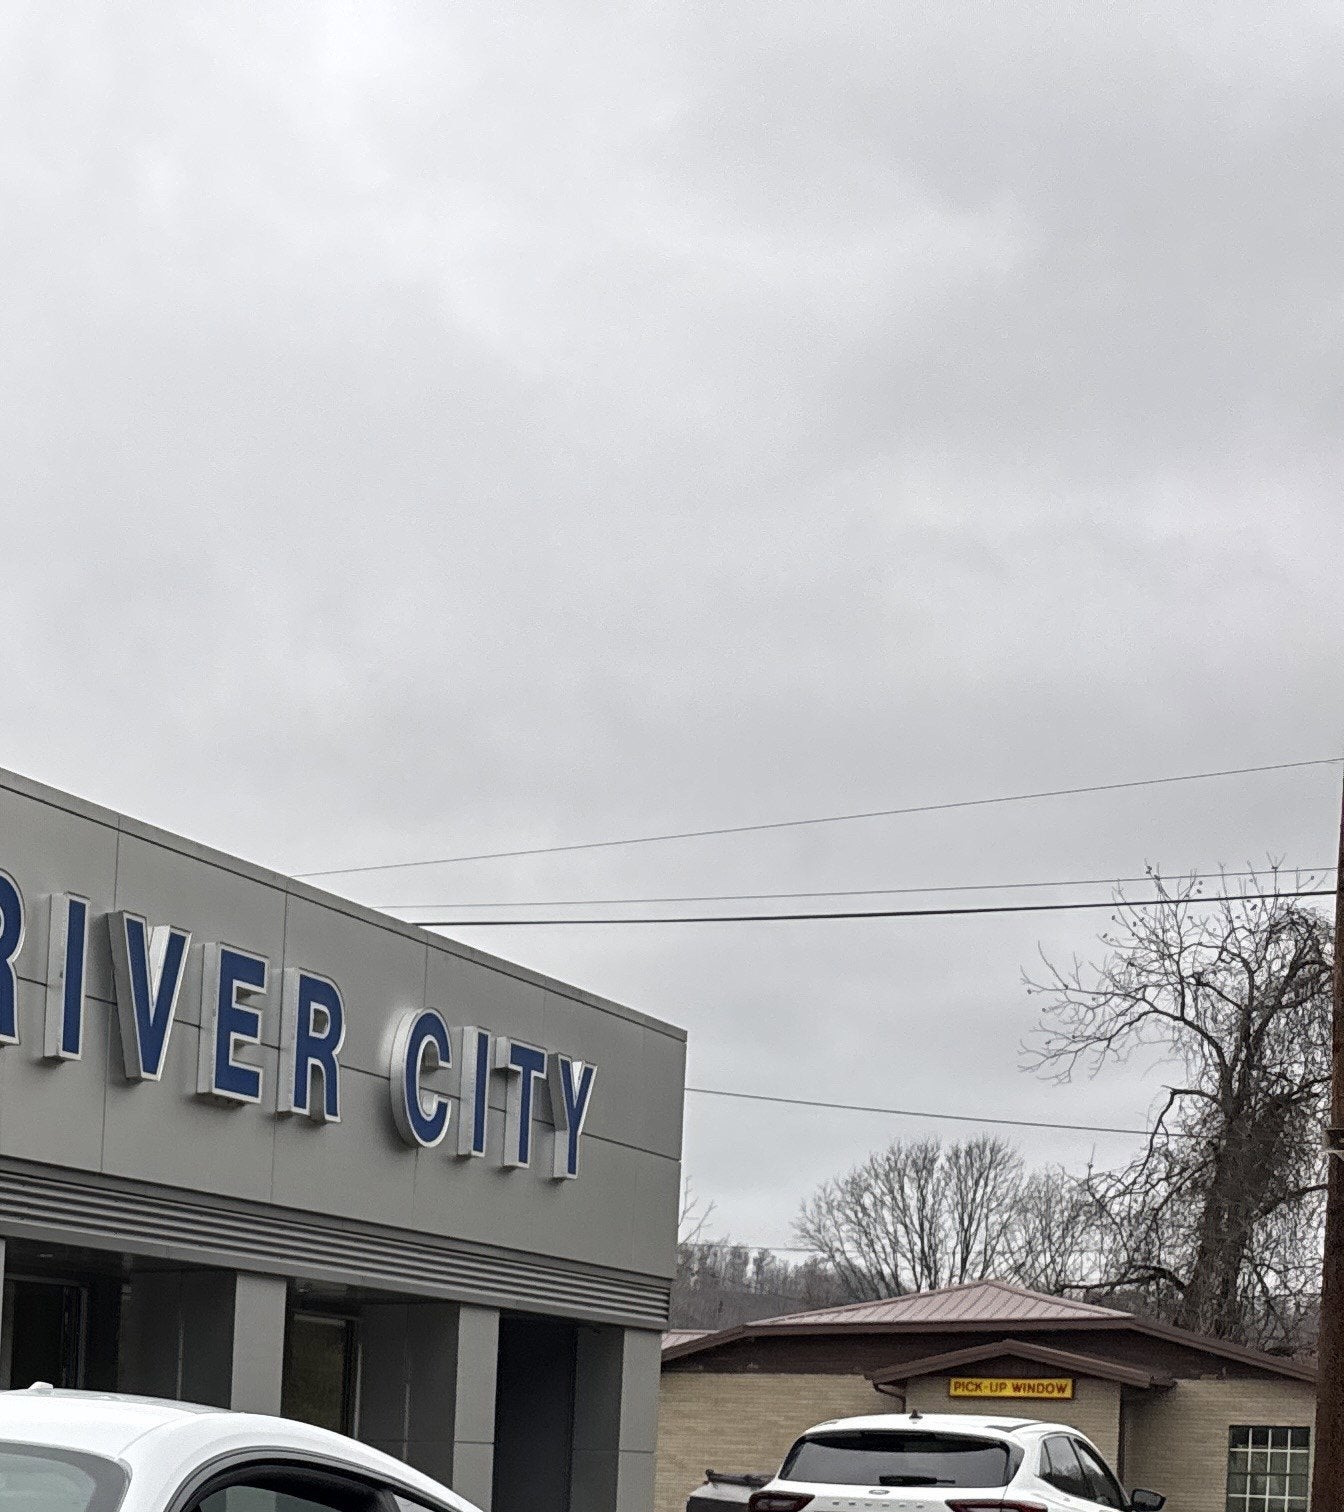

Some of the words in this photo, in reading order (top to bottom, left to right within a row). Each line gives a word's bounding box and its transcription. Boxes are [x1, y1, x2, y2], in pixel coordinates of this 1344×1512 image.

[389, 1007, 599, 1180] CITY
[953, 1380, 1008, 1393] PICK-UP
[1012, 1382, 1069, 1395] WINDOW
